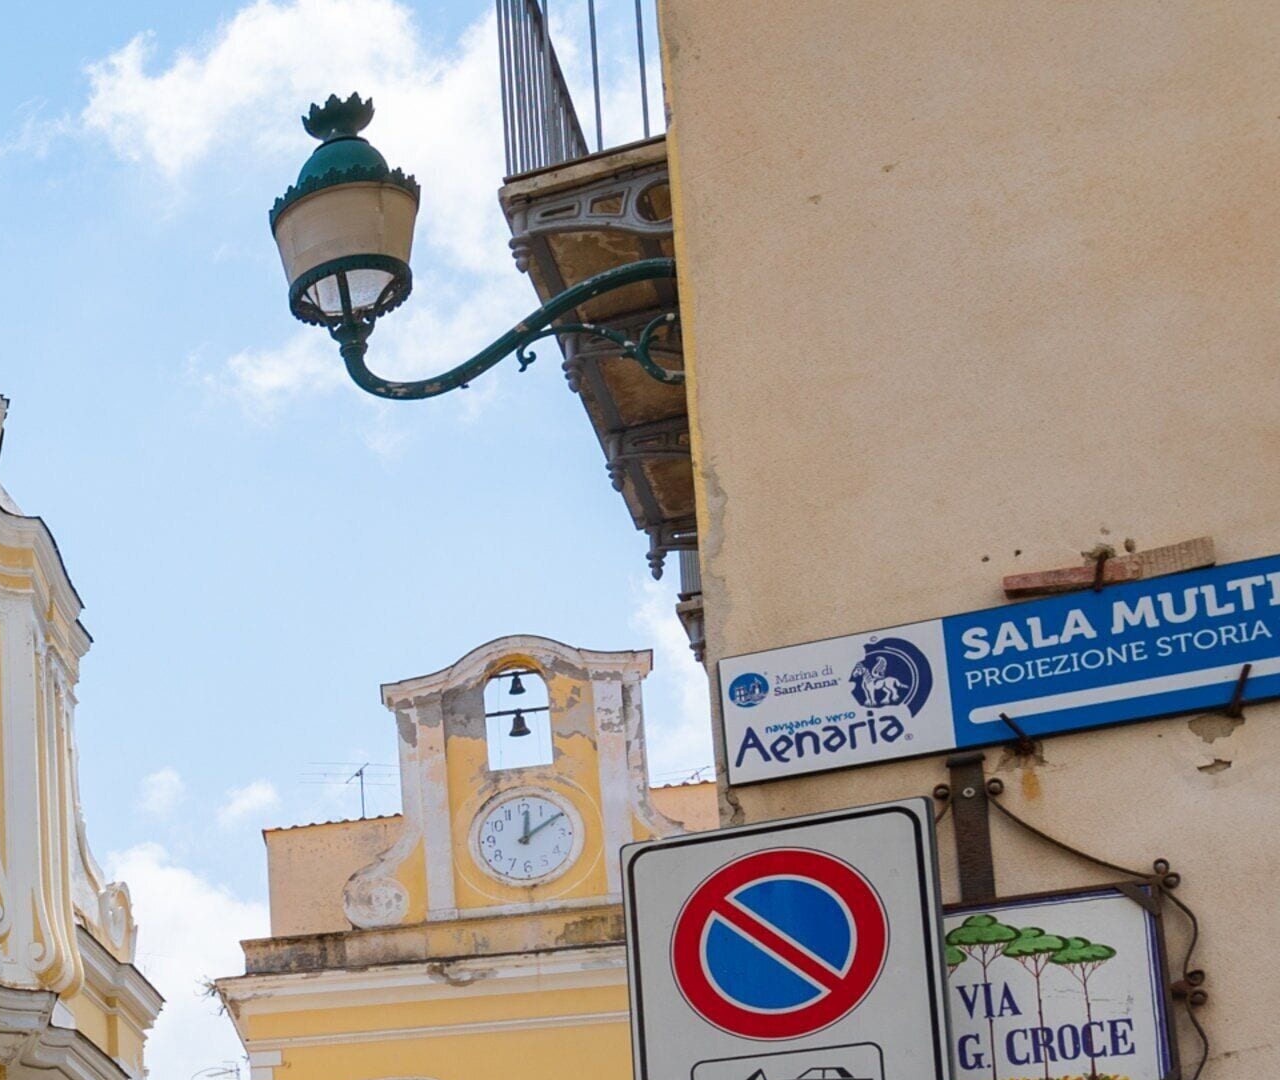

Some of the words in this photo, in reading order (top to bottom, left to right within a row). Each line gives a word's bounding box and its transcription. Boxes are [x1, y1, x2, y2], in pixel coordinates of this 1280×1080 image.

[961, 608, 1098, 661] SALA
[964, 641, 1148, 690] PROIEZIONE
[1156, 620, 1272, 657] STORIA
[774, 678, 838, 697] Sant'Anna
[775, 669, 818, 685] Marina
[821, 665, 834, 677] di
[735, 711, 904, 768] Aenaria
[765, 715, 822, 736] navigando
[825, 711, 856, 723] verso
[956, 981, 1022, 1020] VIA
[957, 1033, 992, 1071] G.
[1005, 1018, 1136, 1066] CROCE
